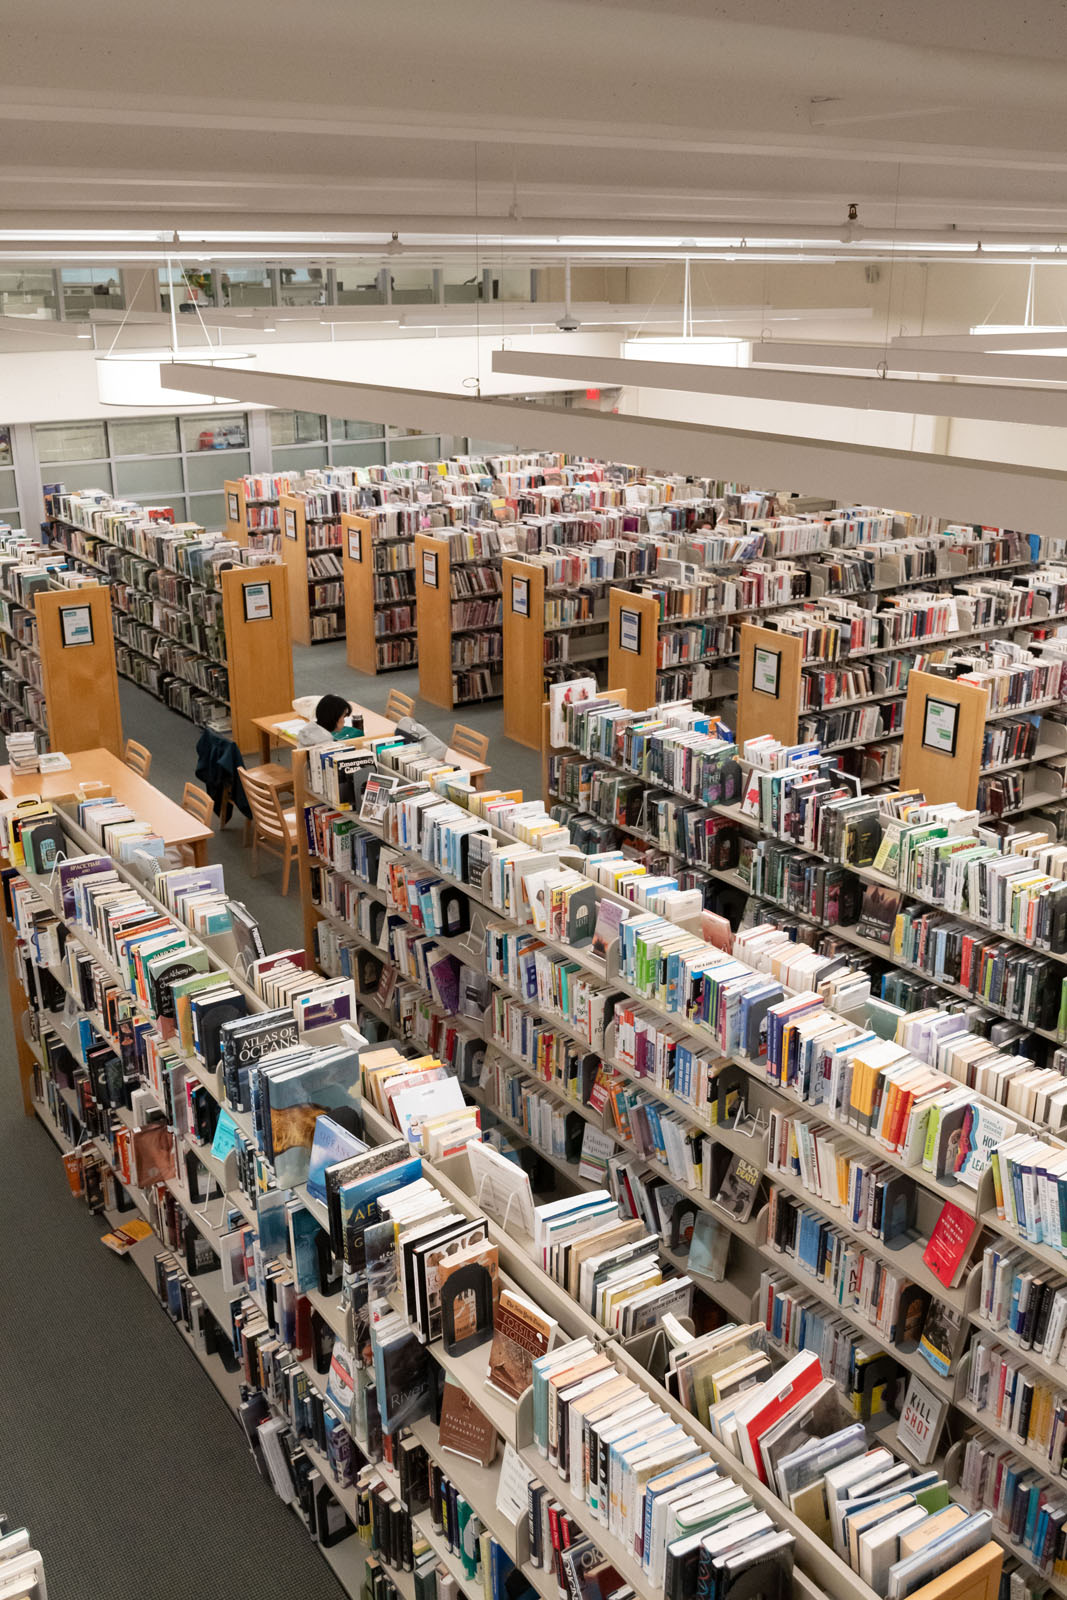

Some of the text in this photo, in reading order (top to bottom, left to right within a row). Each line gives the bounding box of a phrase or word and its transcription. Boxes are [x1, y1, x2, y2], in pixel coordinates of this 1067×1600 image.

[338, 759, 375, 770] Emergency
[239, 1034, 299, 1062] OCEANS
[241, 1026, 296, 1050] ATLAS OF
[735, 1167, 757, 1186] DEATH
[738, 1159, 760, 1178] BLACK
[503, 1315, 535, 1342] FOSSILS
[501, 1324, 542, 1358] EVOLUTION
[445, 1414, 485, 1433] EVOLUTION
[904, 1407, 930, 1441] SHOT
